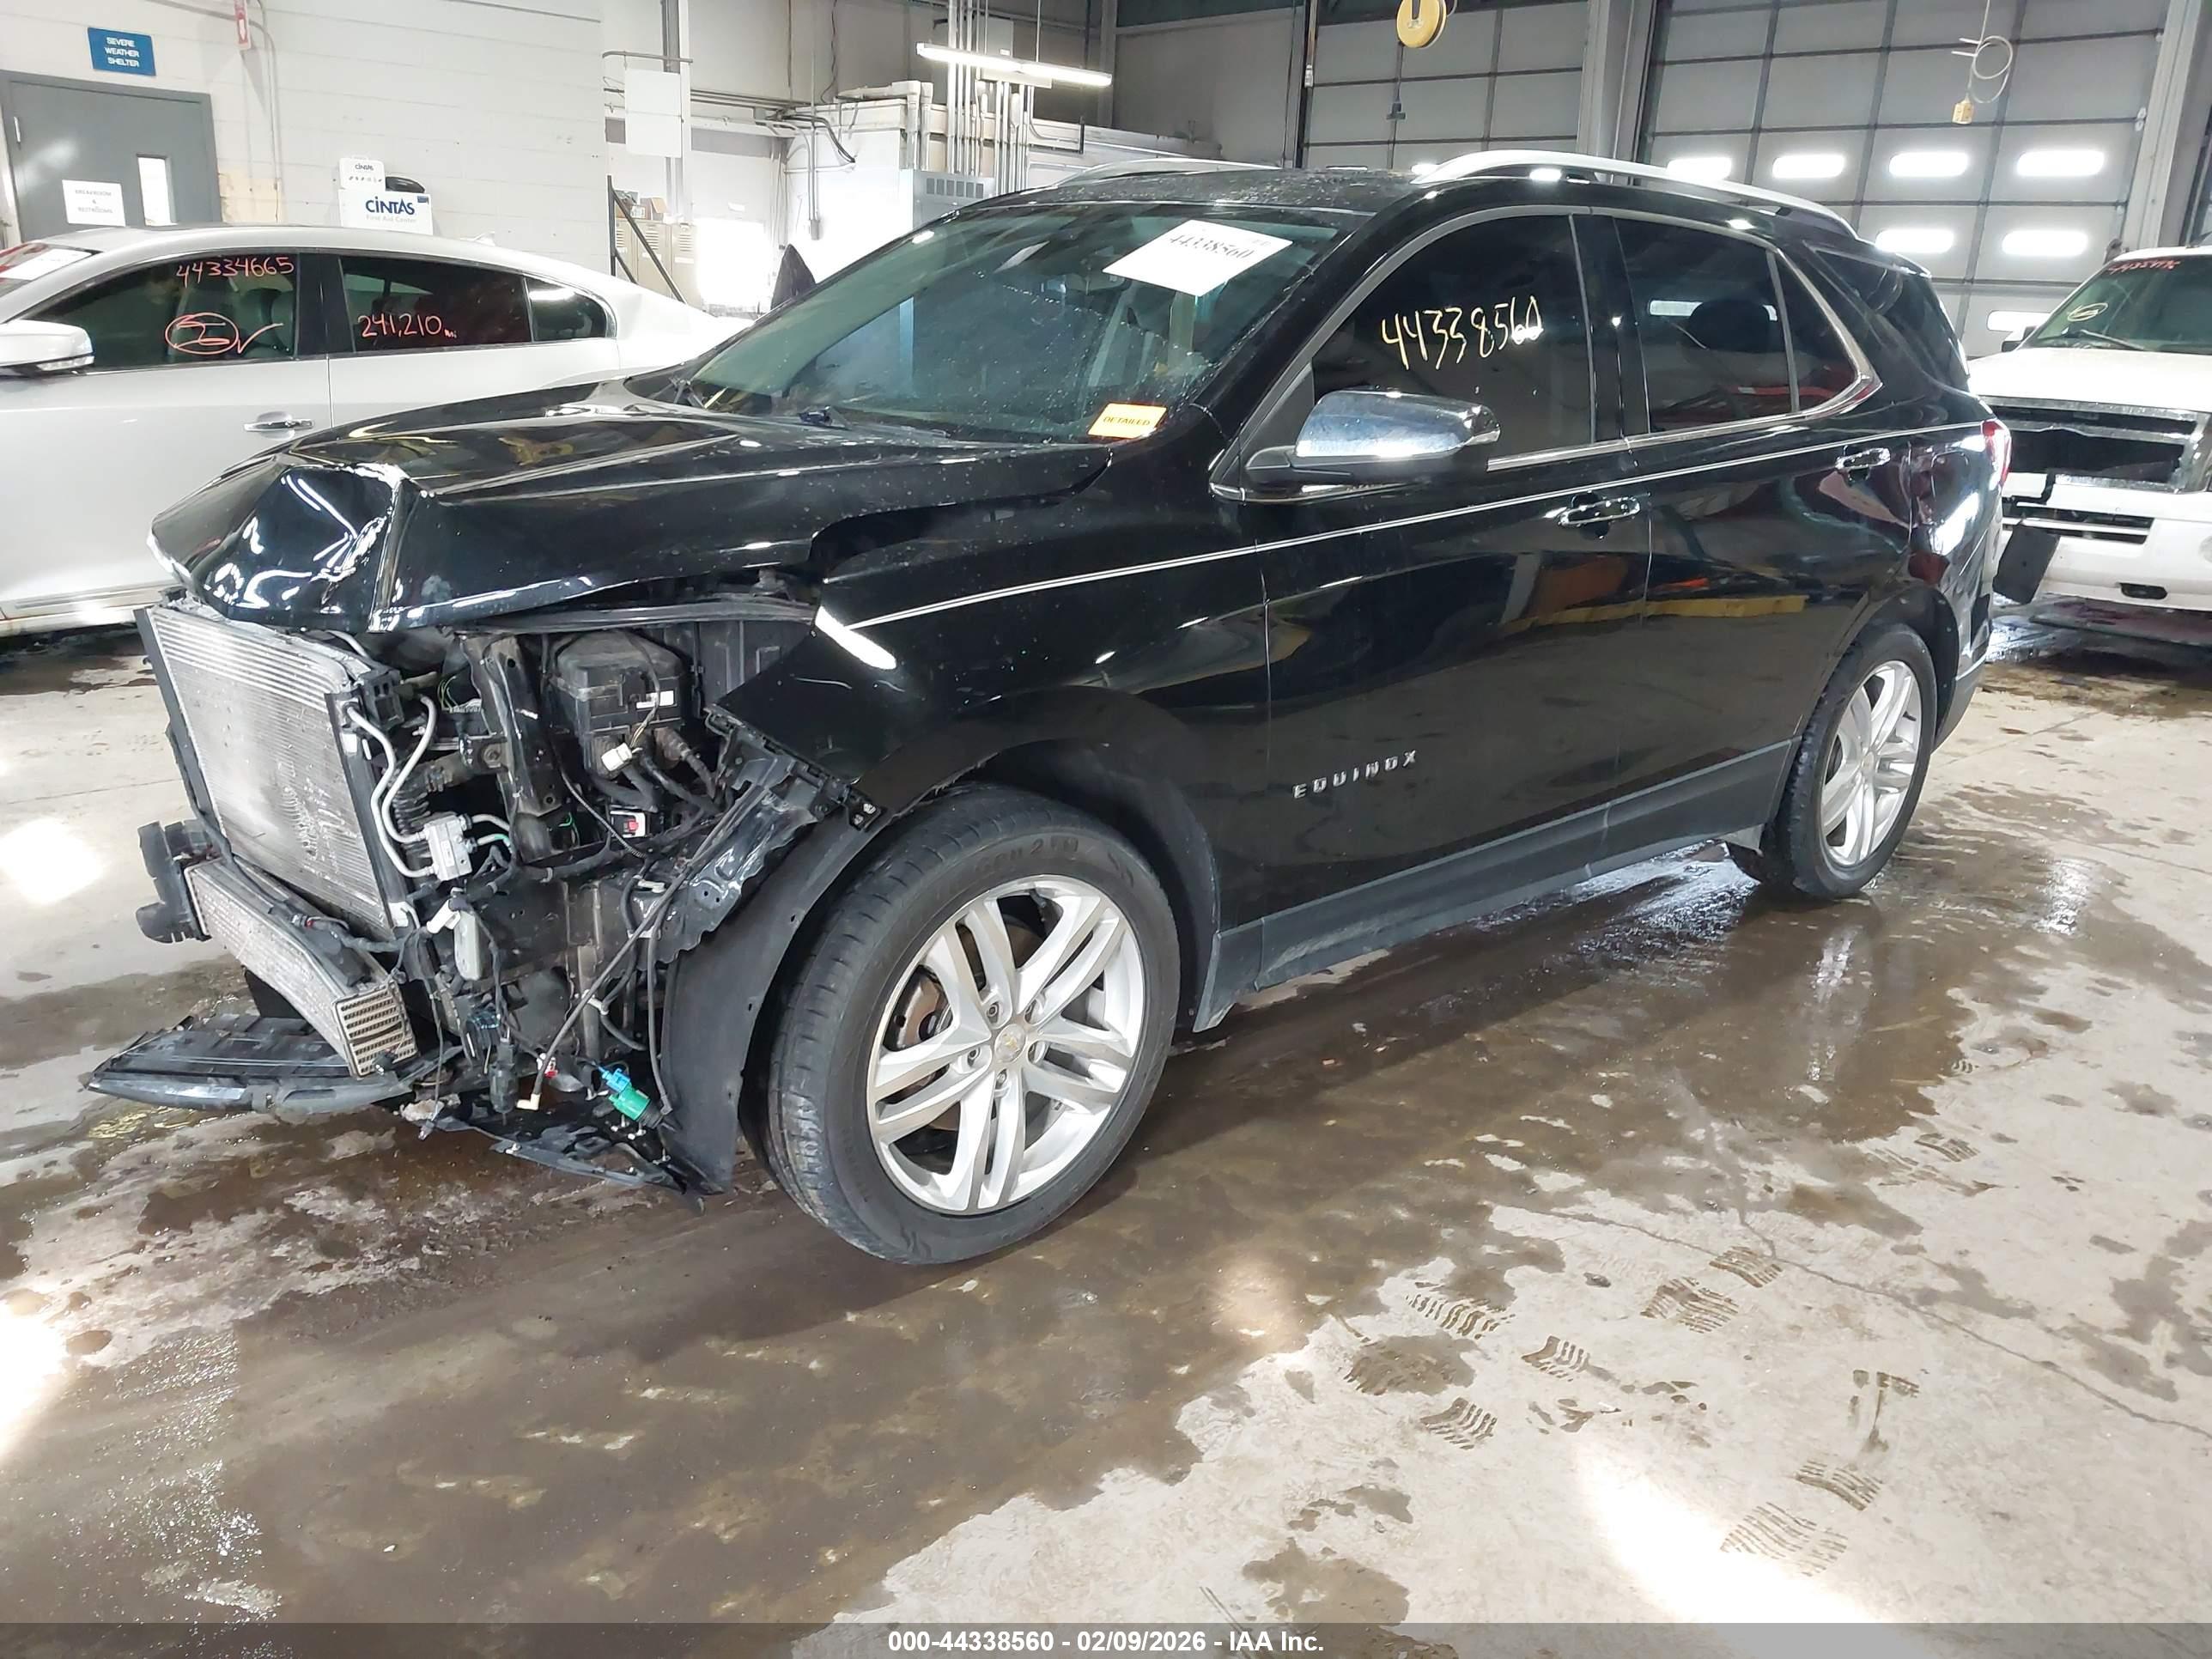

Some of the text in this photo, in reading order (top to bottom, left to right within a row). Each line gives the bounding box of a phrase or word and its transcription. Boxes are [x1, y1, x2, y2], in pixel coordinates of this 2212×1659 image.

[106, 37, 135, 47] SEVERE
[104, 46, 140, 58] WEATHER
[107, 58, 140, 67] SHELTER
[175, 255, 295, 288] 44334665
[357, 313, 442, 338] 241,210
[1381, 295, 1544, 371] 44338560
[1103, 416, 1151, 426] DETAILED
[1292, 749, 1417, 799] EQUINOX
